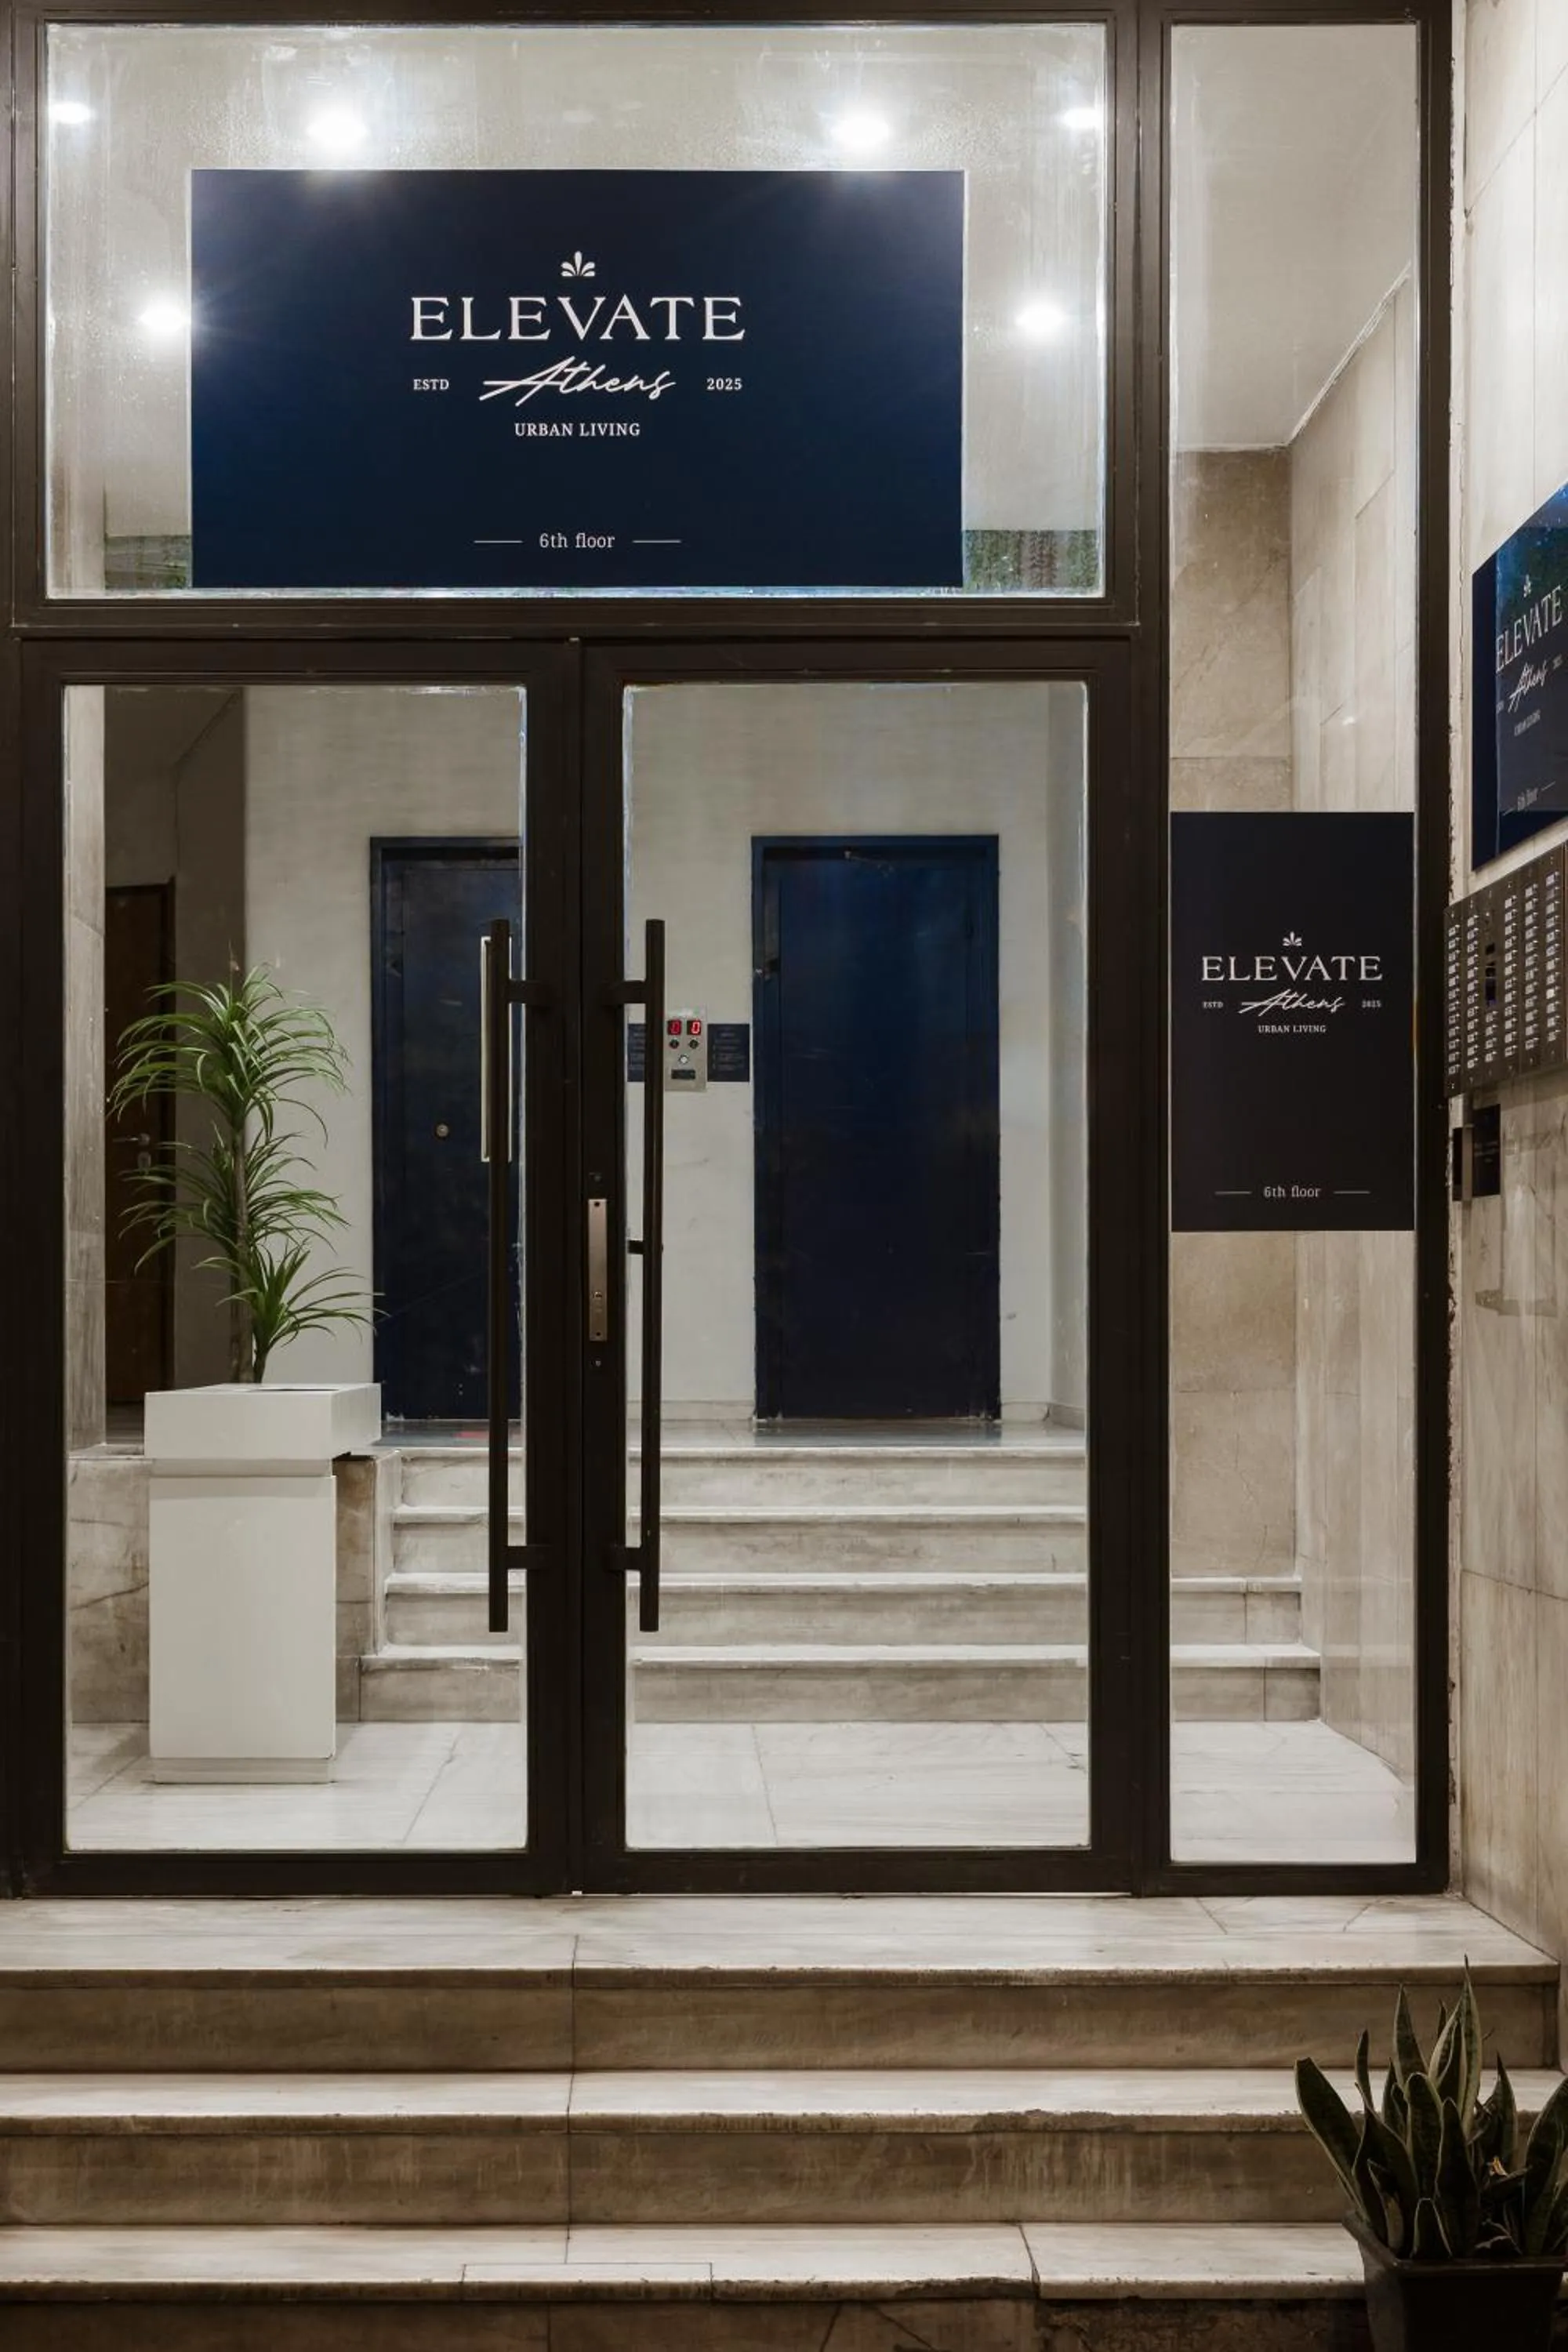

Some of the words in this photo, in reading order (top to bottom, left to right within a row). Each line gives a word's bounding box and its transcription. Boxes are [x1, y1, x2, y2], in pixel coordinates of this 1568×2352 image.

[409, 294, 746, 341] ELEVATE
[413, 379, 449, 390] ESTD
[478, 355, 677, 407] Athens
[706, 377, 742, 390] 2025
[514, 423, 573, 437] URBAN
[579, 423, 641, 437] LIVING
[539, 532, 568, 548] 6th
[575, 532, 615, 548] floor
[1495, 585, 1563, 674] ELEVATE
[1201, 955, 1383, 982] ELEVATE
[1238, 988, 1345, 1017] Athens
[691, 1021, 701, 1034] 0
[1258, 1025, 1290, 1033] URBAN
[1293, 1025, 1327, 1033] LIVING
[1263, 1185, 1286, 1198] 6th
[1291, 1185, 1321, 1198] floor
